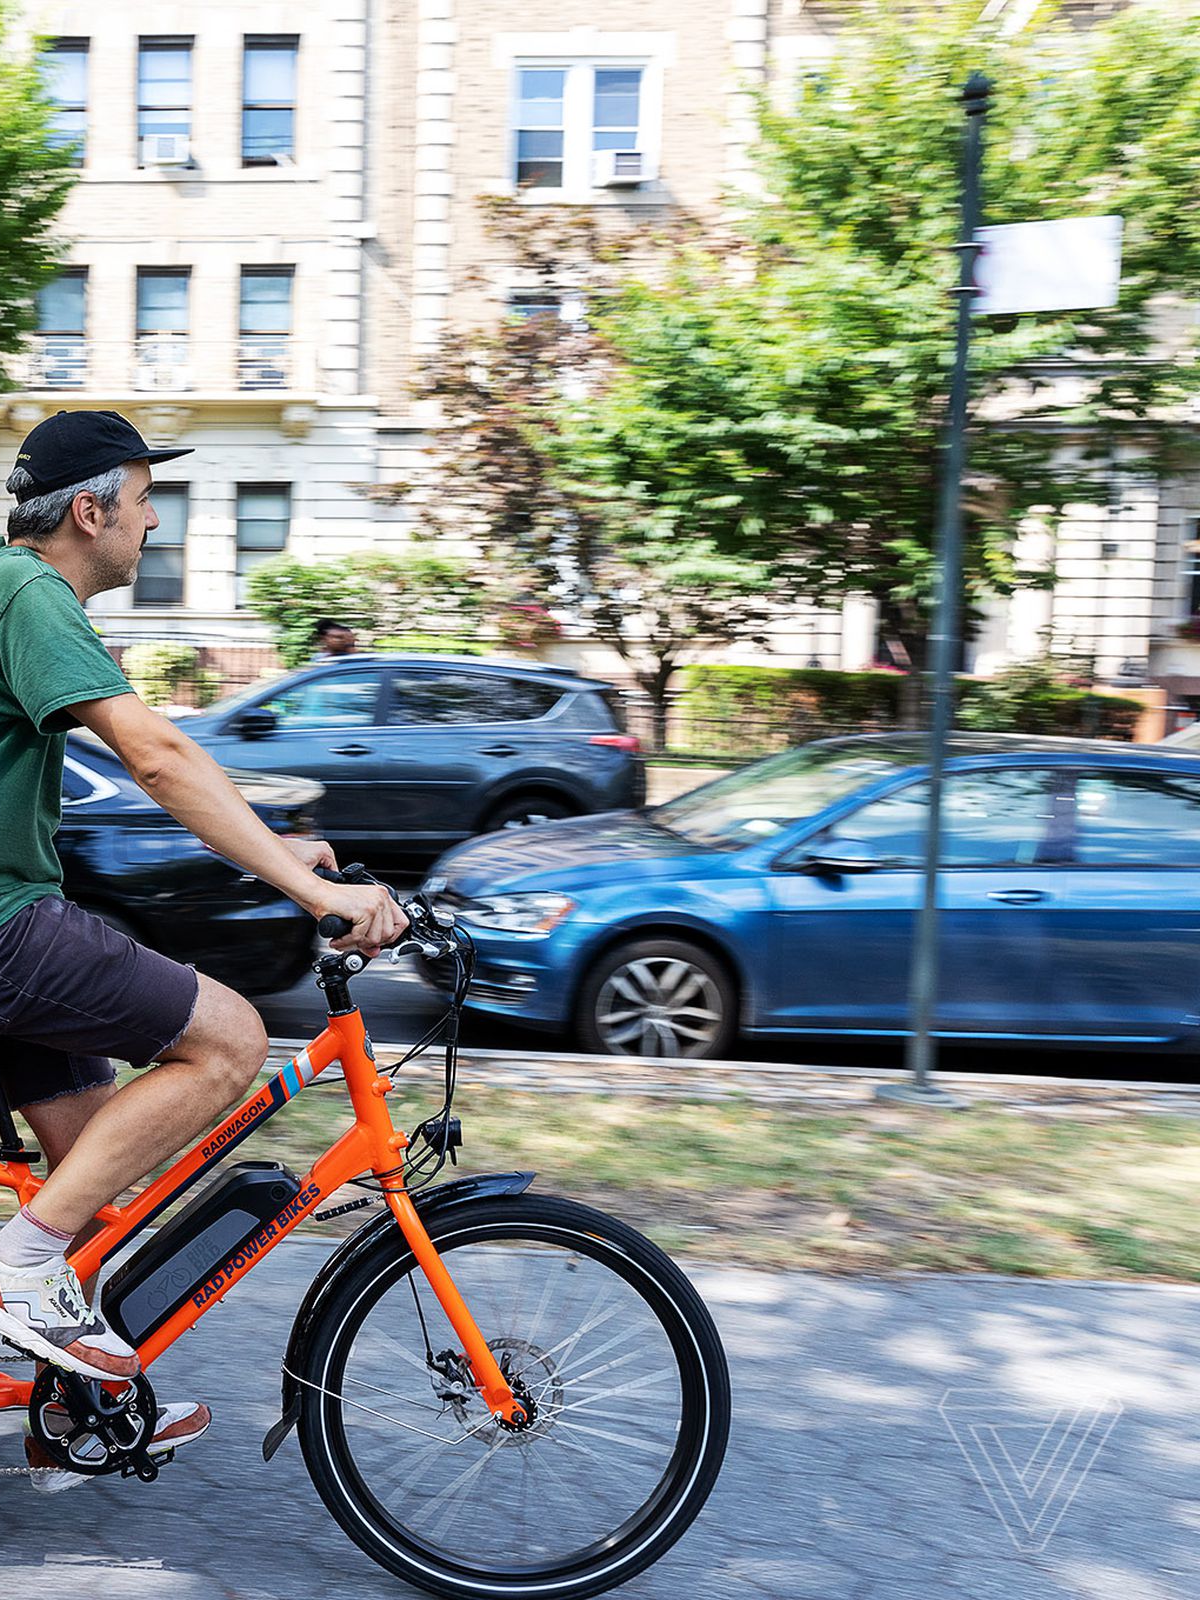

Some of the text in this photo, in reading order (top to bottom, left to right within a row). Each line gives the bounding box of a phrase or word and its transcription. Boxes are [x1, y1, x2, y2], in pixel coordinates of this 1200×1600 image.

[201, 1097, 267, 1159] RADWAGON
[192, 1183, 321, 1308] RAD POWER BIKES
